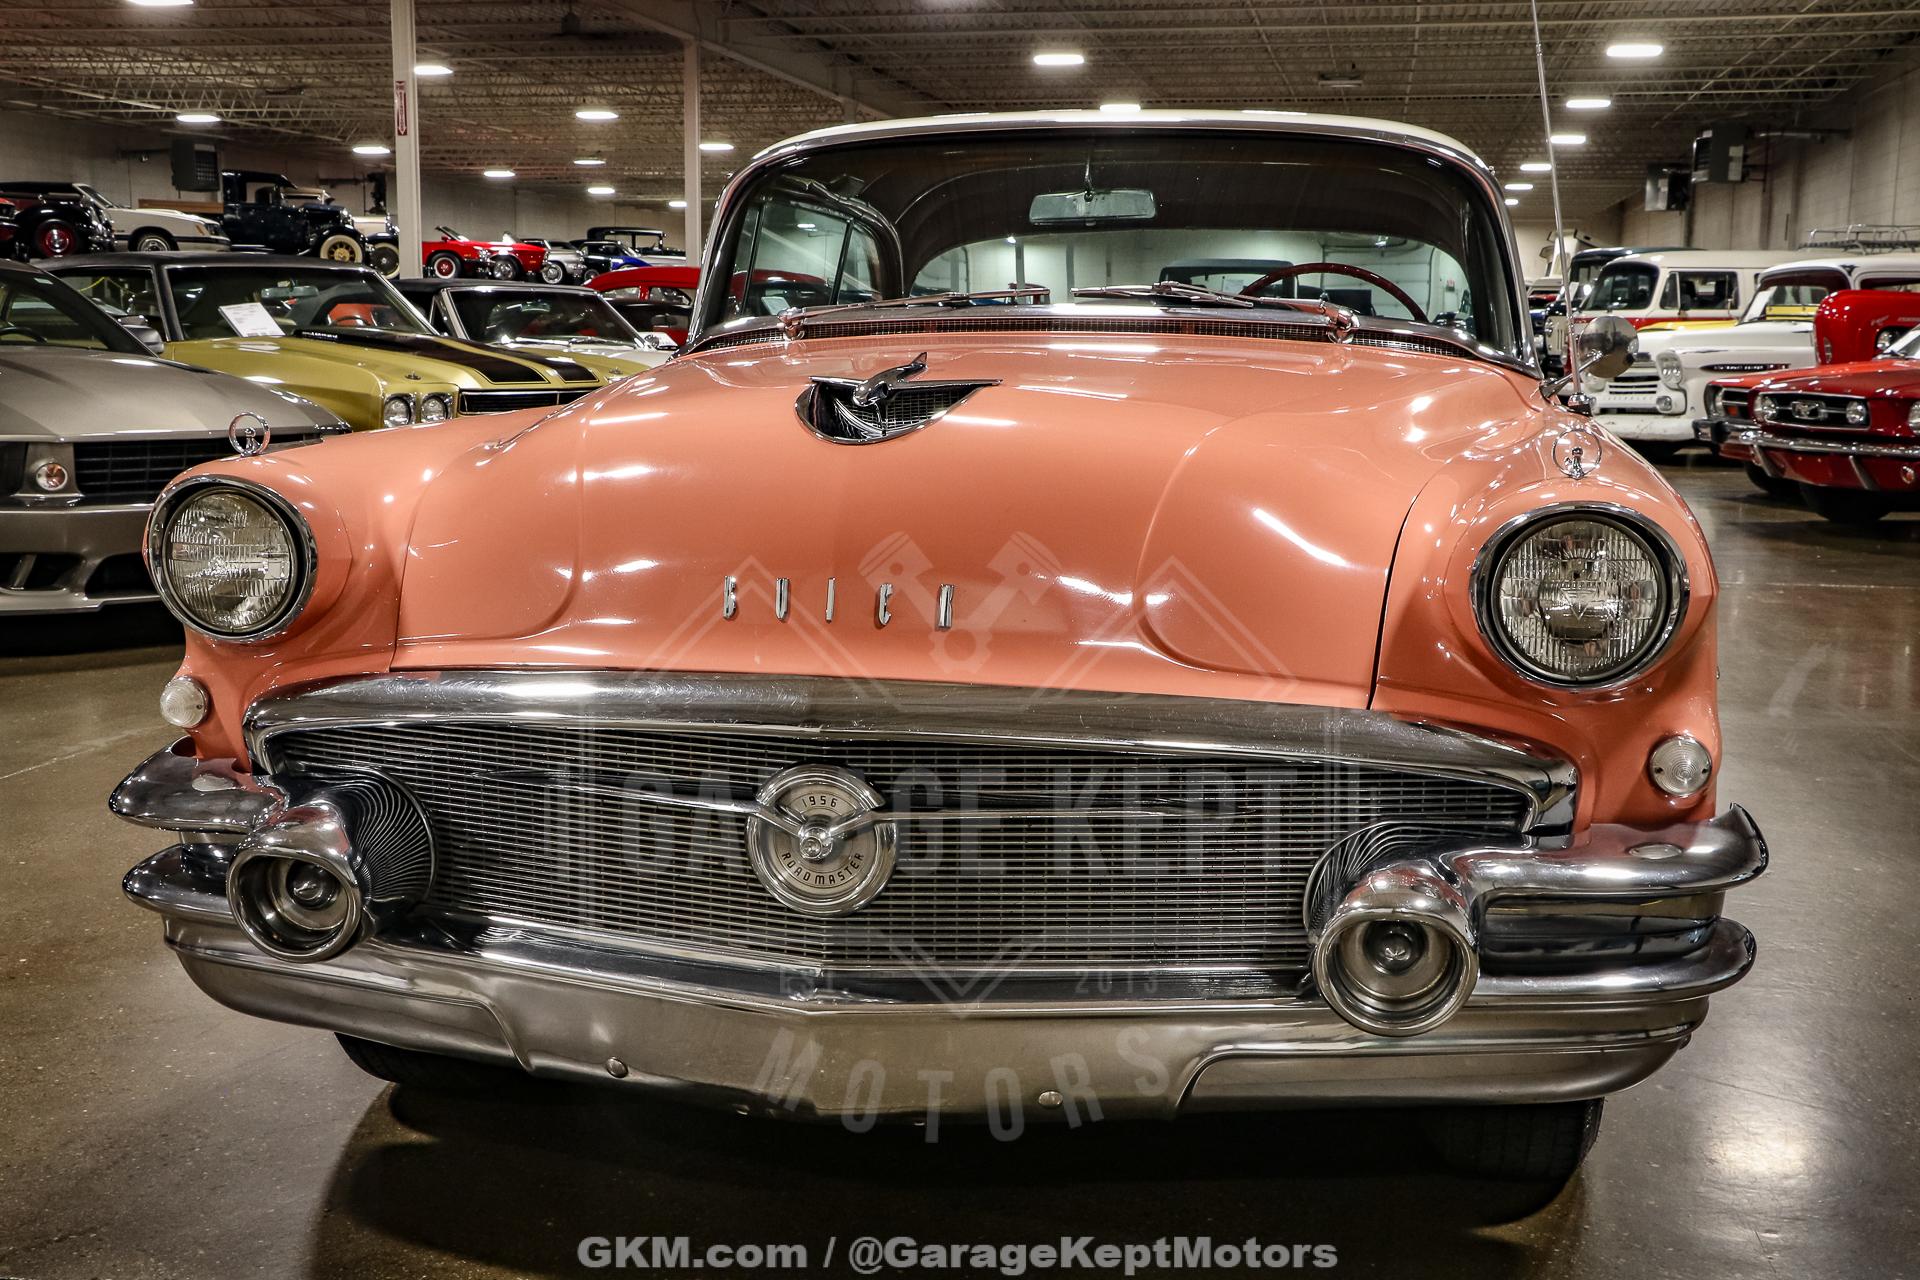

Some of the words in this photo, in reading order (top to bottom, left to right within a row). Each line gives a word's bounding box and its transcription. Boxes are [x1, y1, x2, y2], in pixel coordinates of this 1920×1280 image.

[723, 575, 955, 628] BUICK
[801, 795, 838, 808] 1956
[781, 852, 864, 885] ROADMASTER
